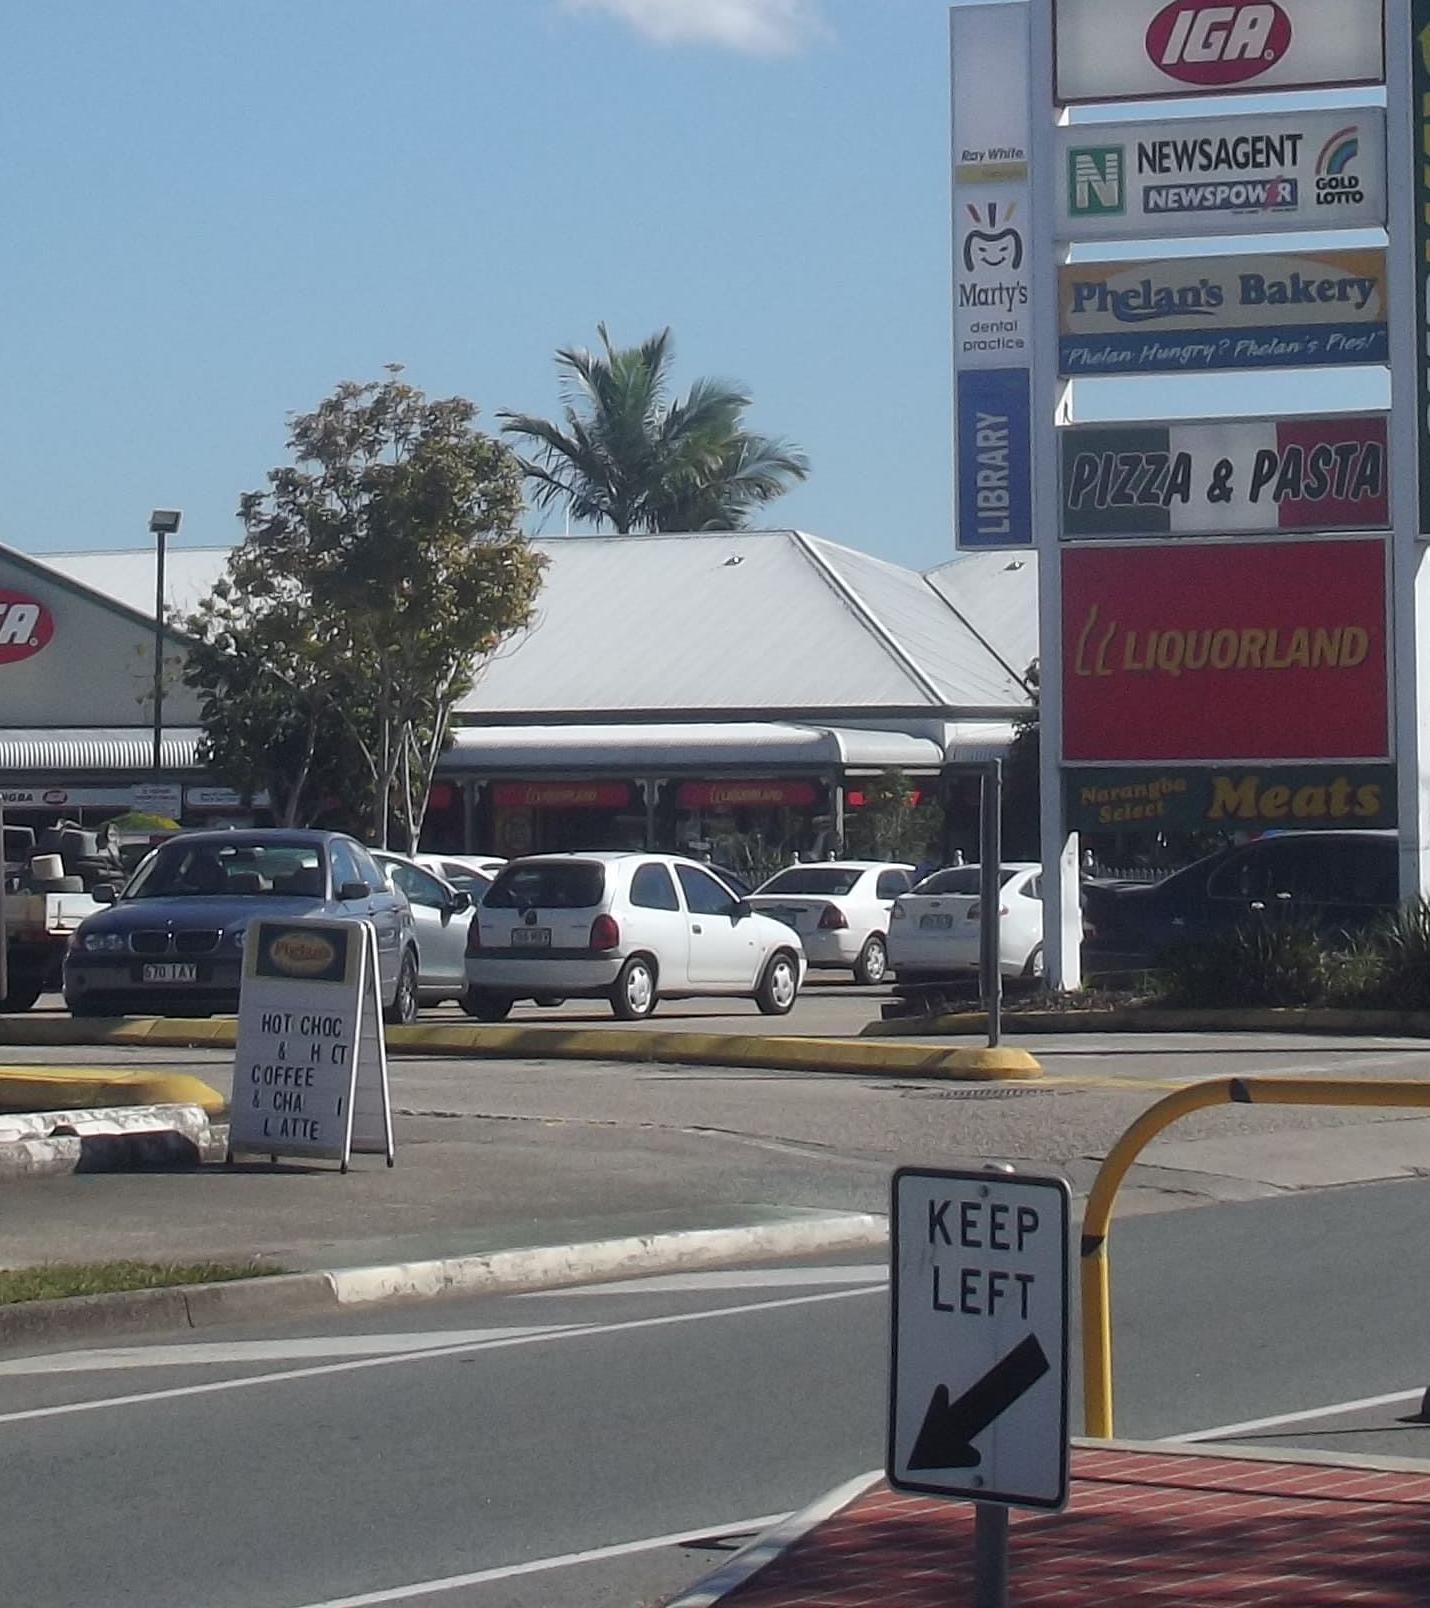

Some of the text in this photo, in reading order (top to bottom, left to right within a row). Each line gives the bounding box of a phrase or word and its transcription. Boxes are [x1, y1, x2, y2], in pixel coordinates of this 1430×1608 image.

[1161, 4, 1276, 65] IGA
[987, 147, 1024, 161] White
[1137, 133, 1303, 174] NEWSAGENT
[1315, 175, 1360, 191] GOLD
[1315, 191, 1364, 206] LOTTO
[959, 280, 1028, 312] Marty's
[1071, 272, 1379, 323] Phelan's Bakery
[970, 320, 1018, 333] dental
[963, 336, 1025, 352] practice
[1138, 339, 1231, 365] Hungry?
[976, 411, 1010, 533] LIBRARY
[1068, 441, 1384, 509] PIZZA & PASTA
[1123, 626, 1369, 677] LIQUORLAND
[1098, 799, 1165, 824] Select
[1206, 776, 1382, 819] Meats
[261, 1012, 343, 1037] HOT CHOC
[251, 1064, 315, 1087] COFFEE
[928, 1199, 1040, 1253] KEEP
[932, 1265, 1036, 1320] LEFT
